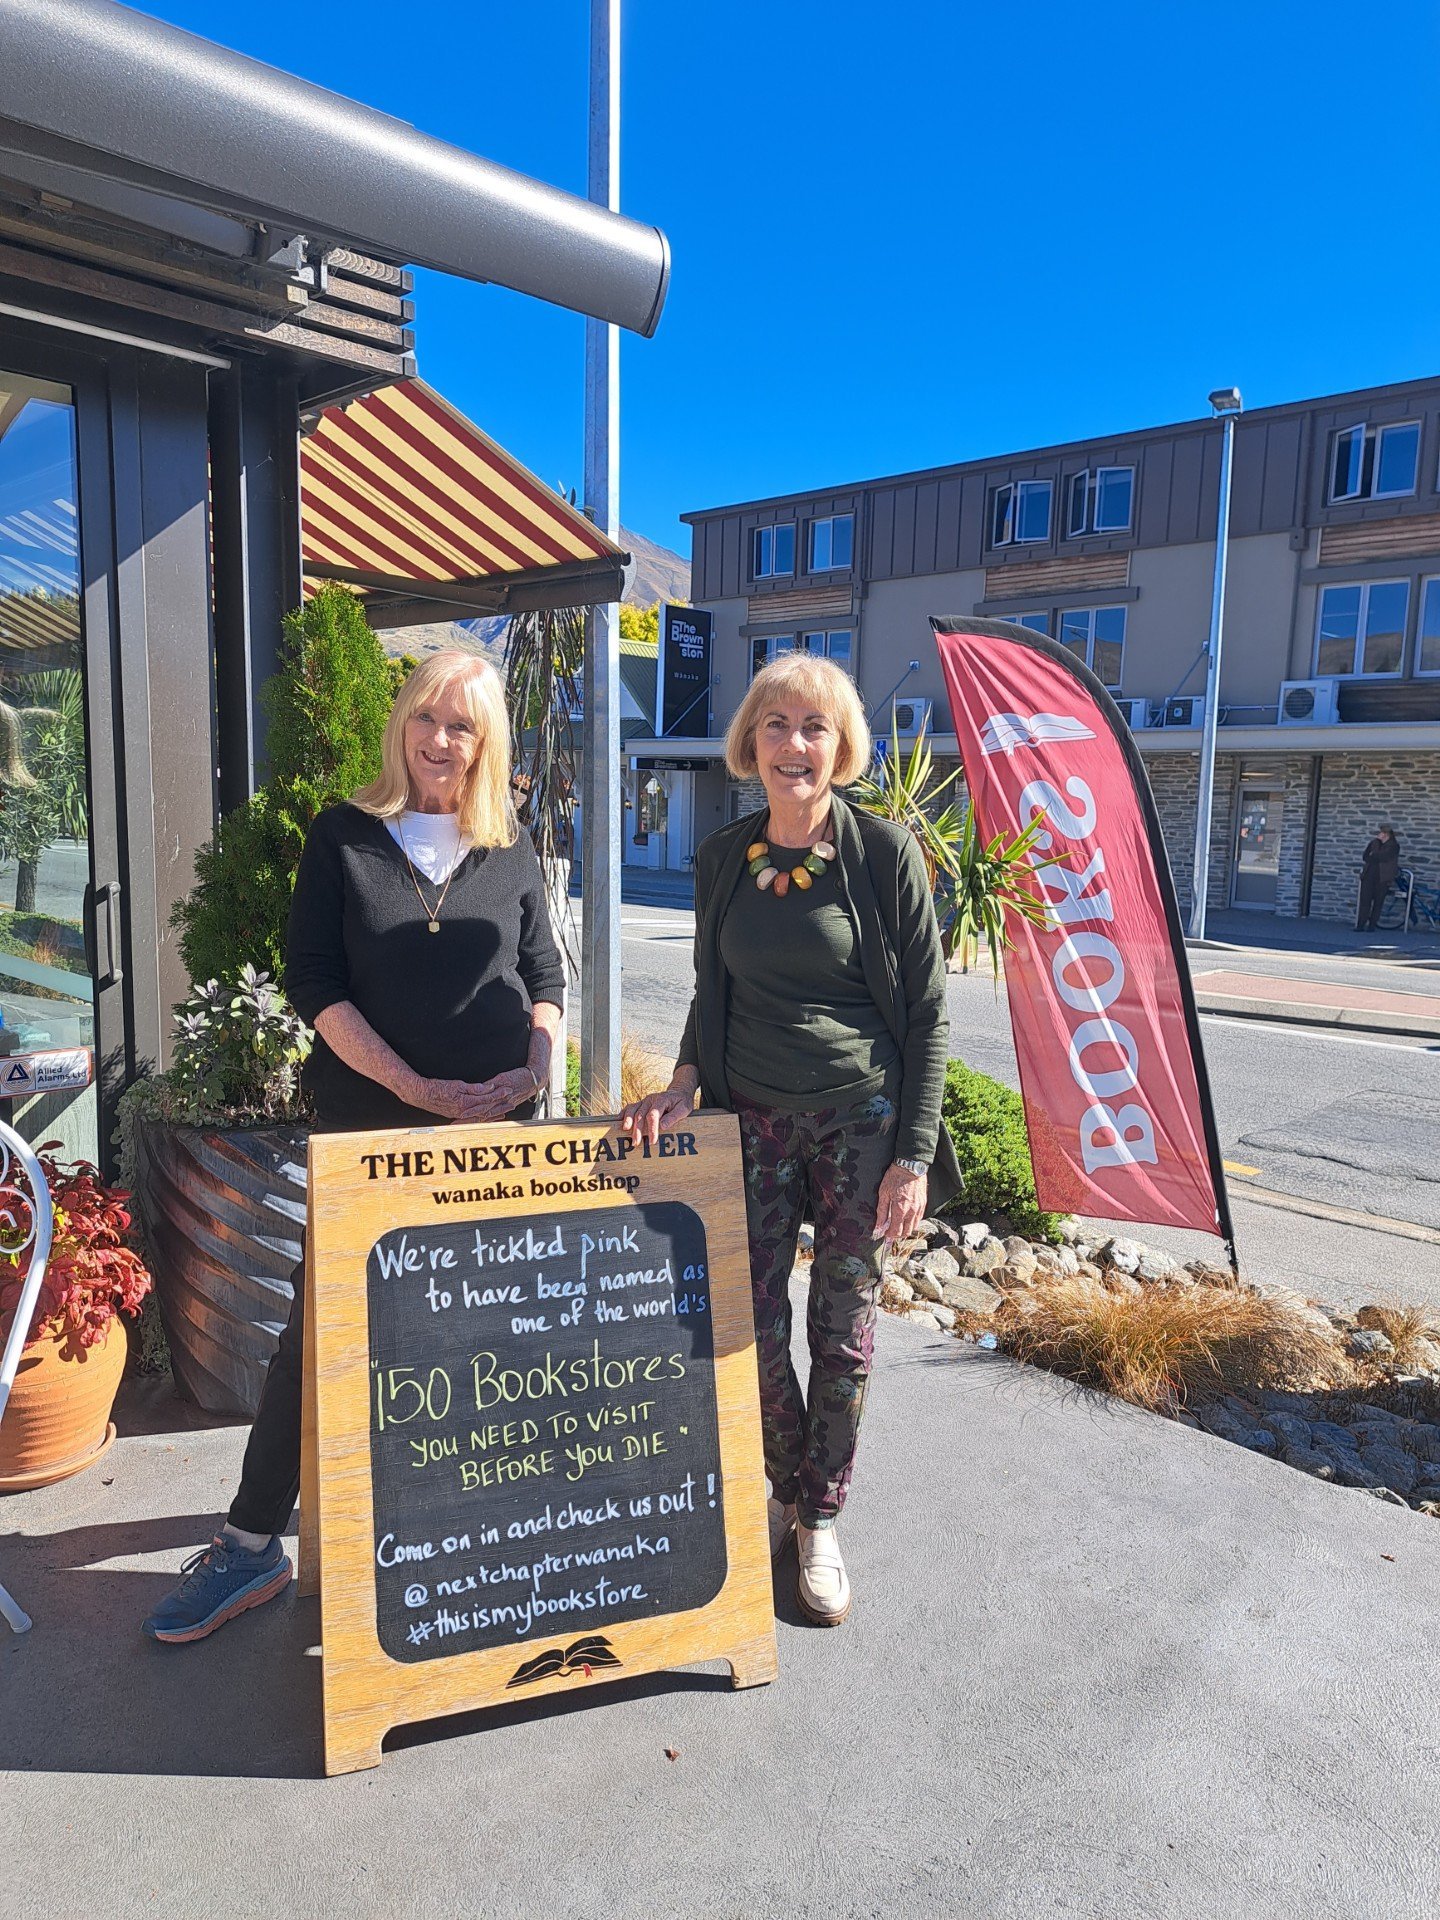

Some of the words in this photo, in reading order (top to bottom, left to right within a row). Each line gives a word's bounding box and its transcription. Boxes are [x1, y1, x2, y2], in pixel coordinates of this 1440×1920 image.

[671, 625, 704, 644] Brown
[672, 620, 696, 634] The
[37, 1066, 62, 1075] Allied
[37, 1073, 70, 1083] Alarms
[72, 1070, 87, 1079] Ltd
[361, 1150, 435, 1180] THE
[443, 1141, 537, 1174] NEXT
[432, 1181, 524, 1205] wanaka
[530, 1172, 641, 1197] bookshop
[375, 1234, 458, 1280] We're
[471, 1225, 567, 1267] tickled
[580, 1225, 640, 1279] pink
[425, 1277, 452, 1313] to
[462, 1280, 528, 1309] have
[537, 1272, 588, 1300] been
[600, 1258, 674, 1292] named
[683, 1264, 705, 1281] as
[511, 1315, 552, 1335] one
[560, 1297, 585, 1326] of
[594, 1299, 629, 1324] the
[633, 1292, 707, 1318] world's
[470, 1338, 686, 1411] Bookstores
[470, 1419, 539, 1451] NEED
[546, 1411, 578, 1439] TO
[459, 1450, 554, 1491] BEFORE
[377, 1533, 439, 1568] Come
[442, 1534, 471, 1554] on
[480, 1523, 500, 1546] in
[507, 1504, 552, 1539] and
[556, 1498, 621, 1530] check
[629, 1496, 652, 1518] us
